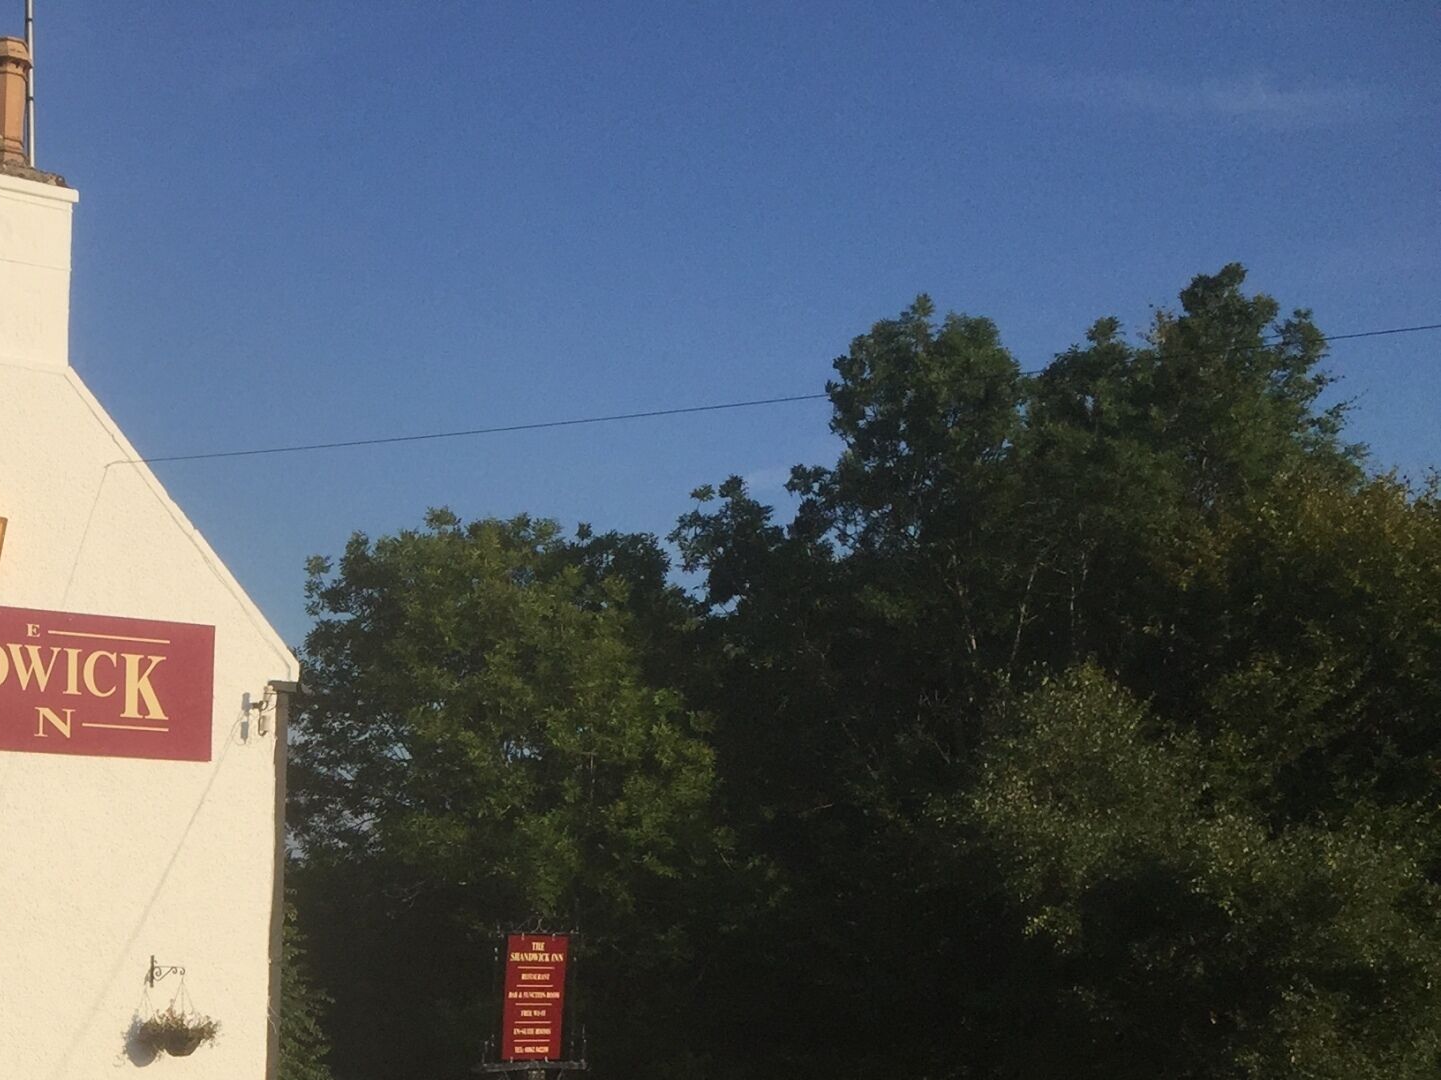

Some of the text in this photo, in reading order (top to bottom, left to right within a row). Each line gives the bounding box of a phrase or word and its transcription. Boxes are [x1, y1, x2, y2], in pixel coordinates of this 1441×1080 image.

[532, 942, 545, 951] THE
[510, 952, 564, 962] SHANDWICK INN
